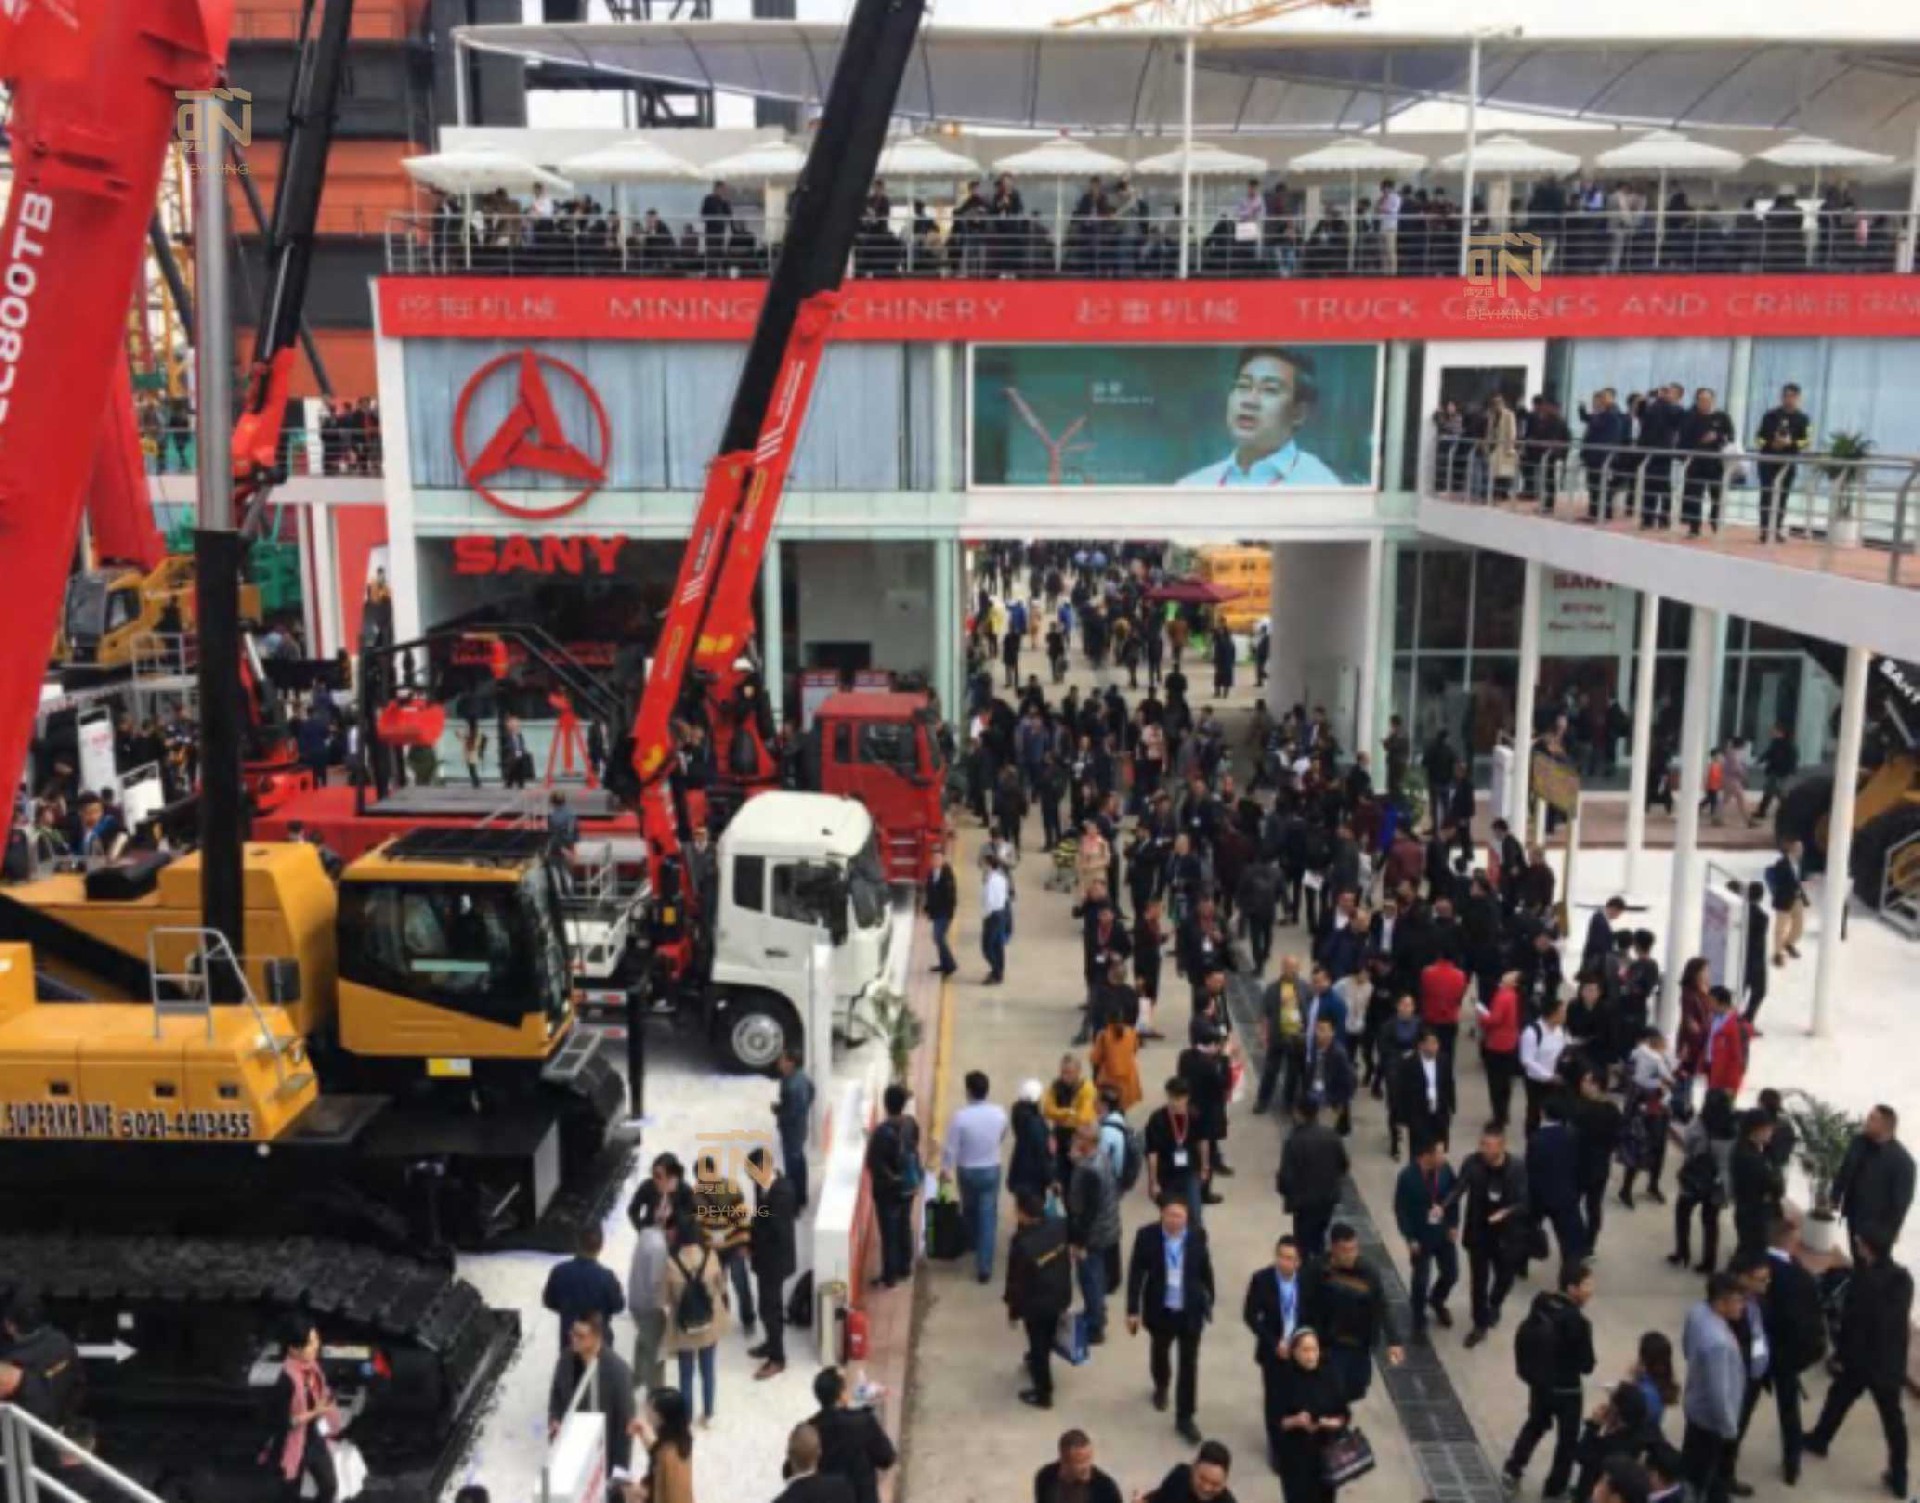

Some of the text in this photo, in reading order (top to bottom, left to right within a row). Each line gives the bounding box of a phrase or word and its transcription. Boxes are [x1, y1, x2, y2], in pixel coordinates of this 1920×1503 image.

[609, 296, 1006, 323] MINING CHINERY
[1294, 297, 1420, 323] TRUCK
[1620, 293, 1710, 318] AND
[453, 533, 630, 574] SANY
